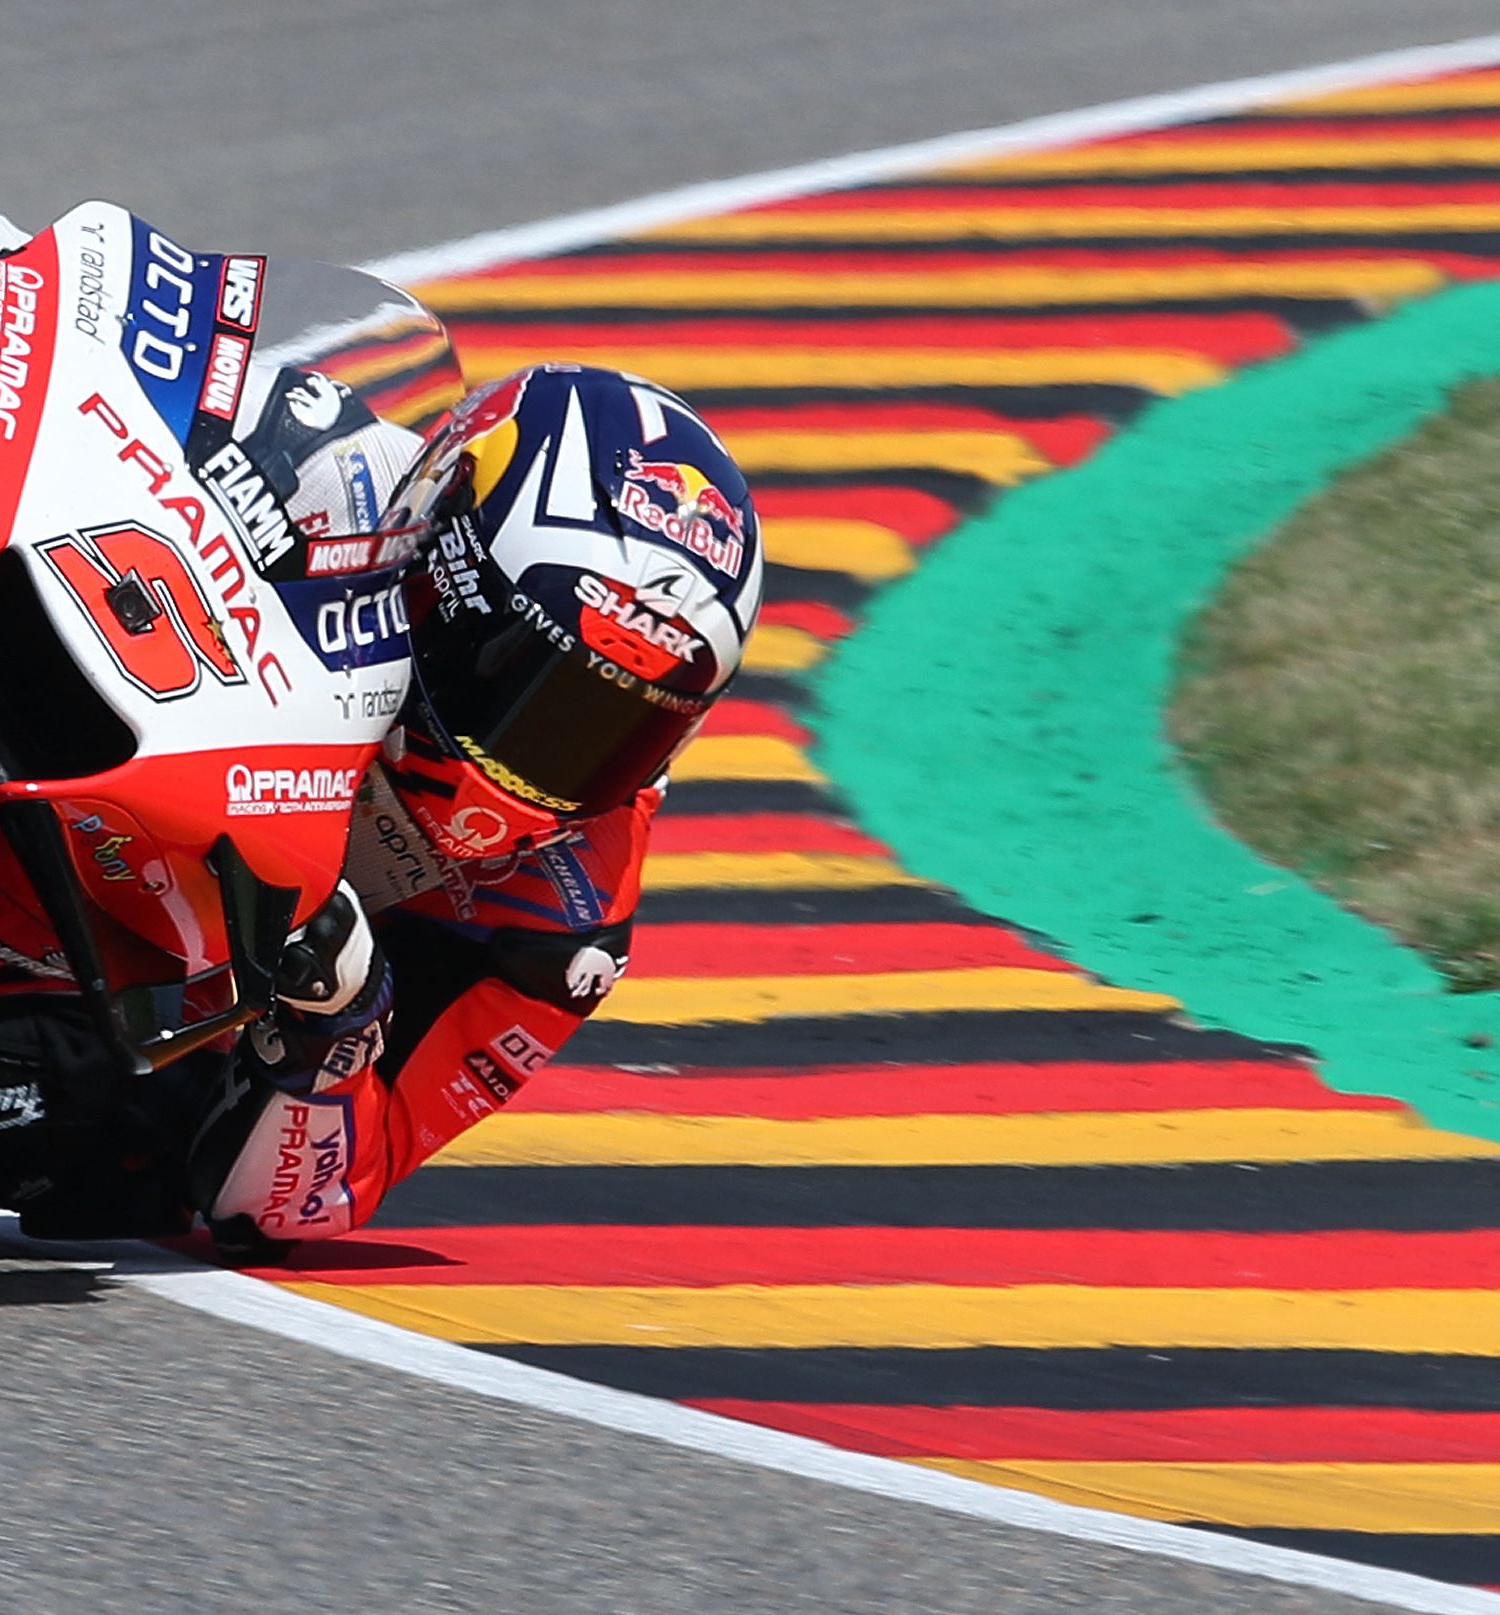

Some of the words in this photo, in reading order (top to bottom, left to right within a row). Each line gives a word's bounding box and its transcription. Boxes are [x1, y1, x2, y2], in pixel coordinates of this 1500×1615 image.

[75, 246, 112, 346] randstad
[134, 231, 194, 381] OCTO
[222, 258, 259, 327] WRS
[204, 336, 245, 412] MOTUL
[79, 391, 293, 709] PRAMAC
[204, 442, 295, 567] FIAMM
[31, 518, 252, 703] 5
[510, 593, 576, 653] GIVES
[585, 650, 638, 689] YOU
[574, 574, 706, 665] SHARK
[253, 768, 358, 800] PRAMAC
[375, 814, 427, 891] april
[258, 1104, 310, 1229] PRAMAC
